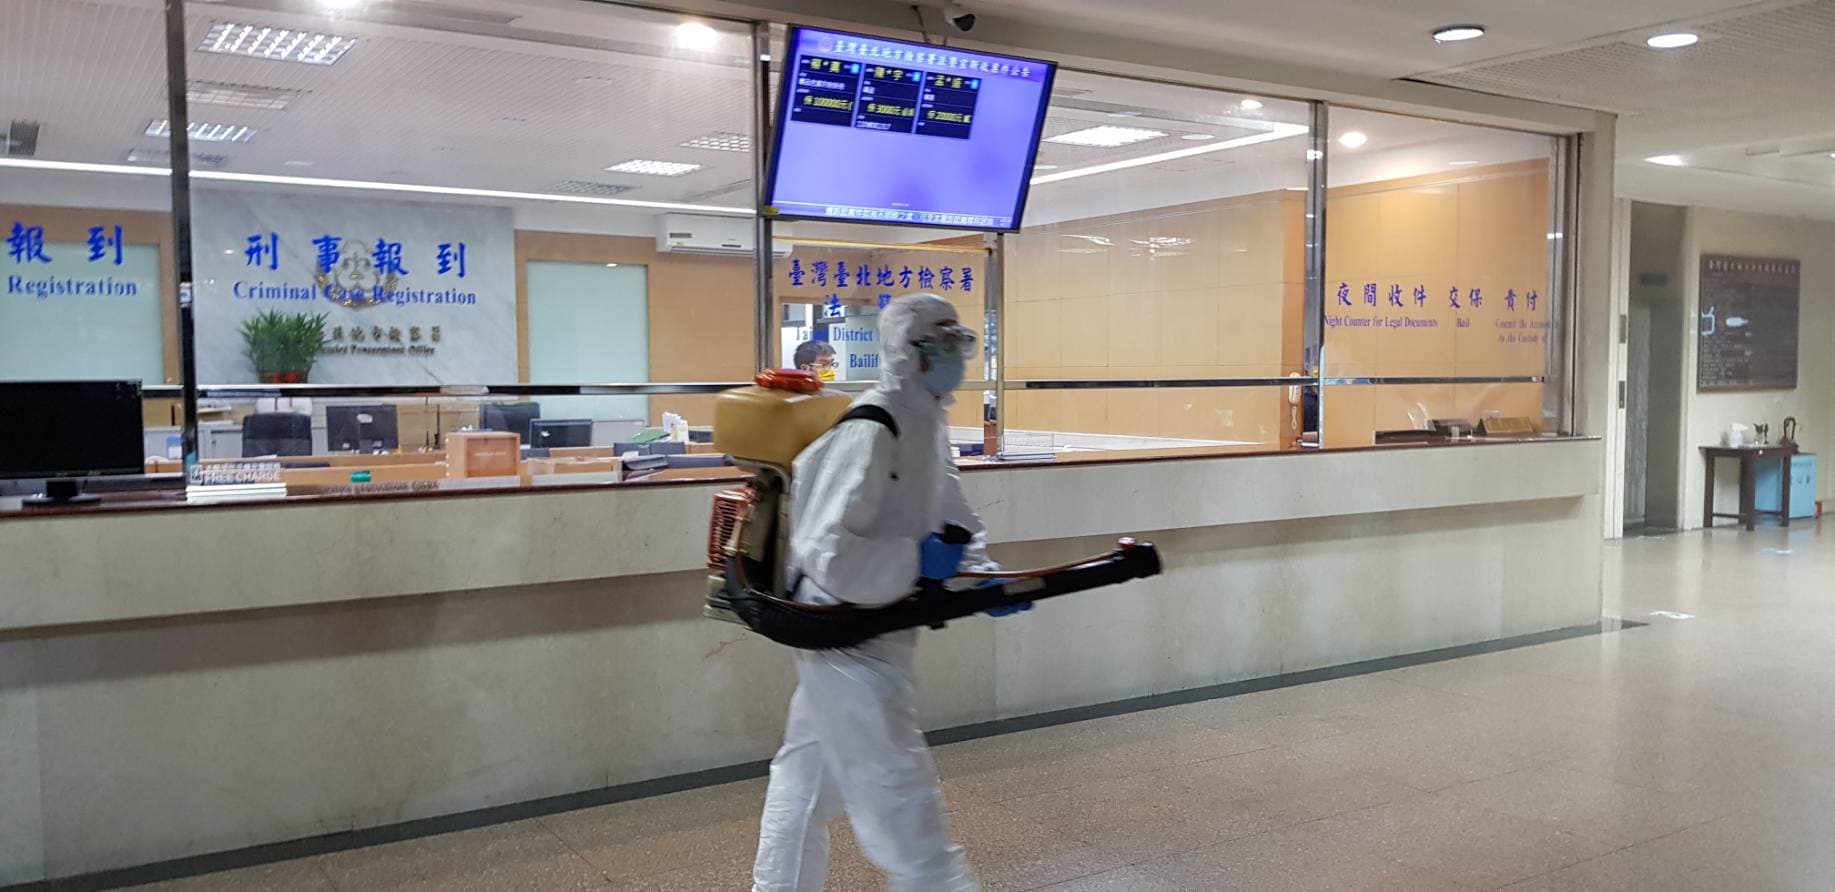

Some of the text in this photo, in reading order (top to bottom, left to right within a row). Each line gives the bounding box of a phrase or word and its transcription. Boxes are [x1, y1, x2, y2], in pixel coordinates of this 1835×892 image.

[6, 222, 123, 265] 報到
[244, 232, 466, 278] 刑事報到
[8, 275, 137, 298] Registration
[788, 259, 974, 292] 臺灣臺北地方檢察署
[233, 280, 476, 305] Criminal Case Registration
[1337, 282, 1427, 308] 夜間收件
[1449, 286, 1483, 309] 交保
[833, 326, 873, 341] District
[1324, 315, 1342, 327] Night
[1344, 316, 1371, 327] Counter
[1372, 315, 1383, 327] for
[1385, 315, 1402, 328] Legal
[849, 353, 880, 368] Bailif
